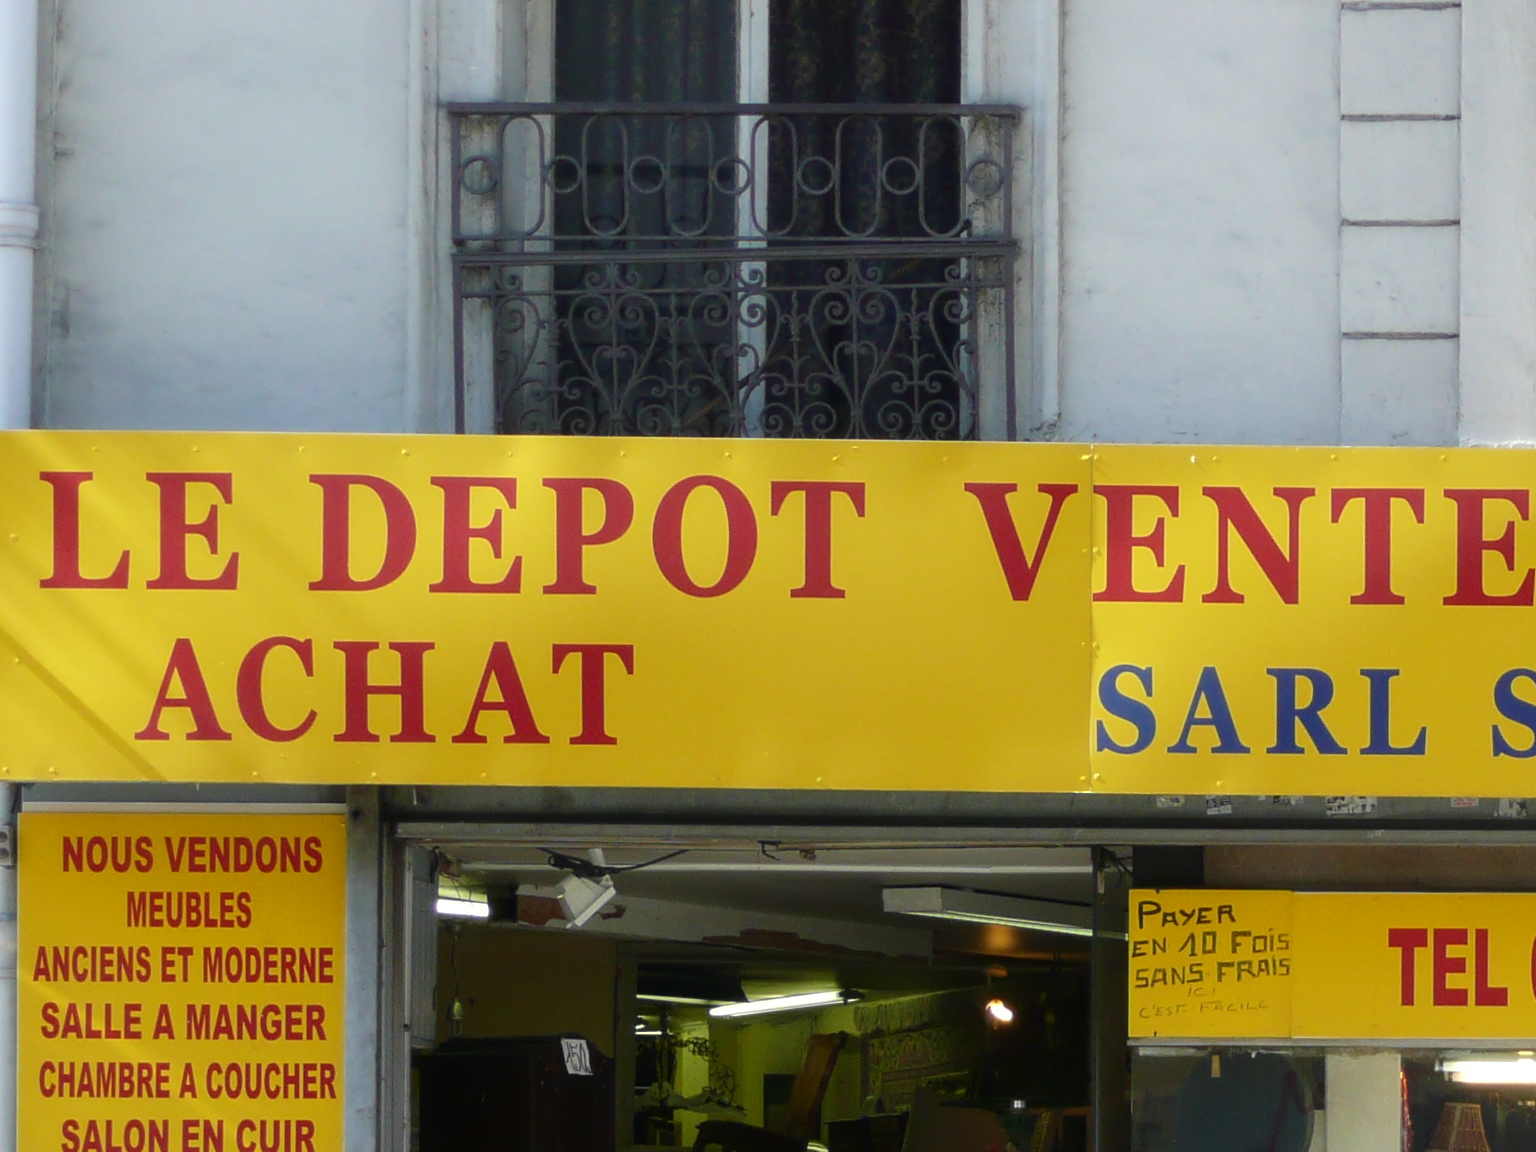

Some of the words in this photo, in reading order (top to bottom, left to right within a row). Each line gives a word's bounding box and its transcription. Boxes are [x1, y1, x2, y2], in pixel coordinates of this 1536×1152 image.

[40, 471, 239, 591] LE
[309, 473, 866, 599] DEPOT
[964, 482, 1536, 607] VENTE
[135, 636, 635, 746] ACHAT
[1097, 664, 1426, 755] SARL
[62, 835, 154, 874] NOUS
[165, 835, 323, 874] VENDONS
[127, 891, 253, 929] MEUBLES
[1132, 938, 1168, 958] EN
[1178, 931, 1217, 957] 10
[33, 945, 152, 983] ANCIENS
[161, 946, 195, 983] ET
[203, 946, 334, 984] MODERNE
[1134, 963, 1203, 989] SANS
[1388, 927, 1509, 1007] TEL
[41, 1002, 143, 1040] SALLE
[153, 1003, 175, 1040] A
[186, 1003, 327, 1041] MANGER
[39, 1061, 171, 1099] CHAMBRE
[179, 1063, 198, 1099] A
[206, 1062, 337, 1100] COUCHER
